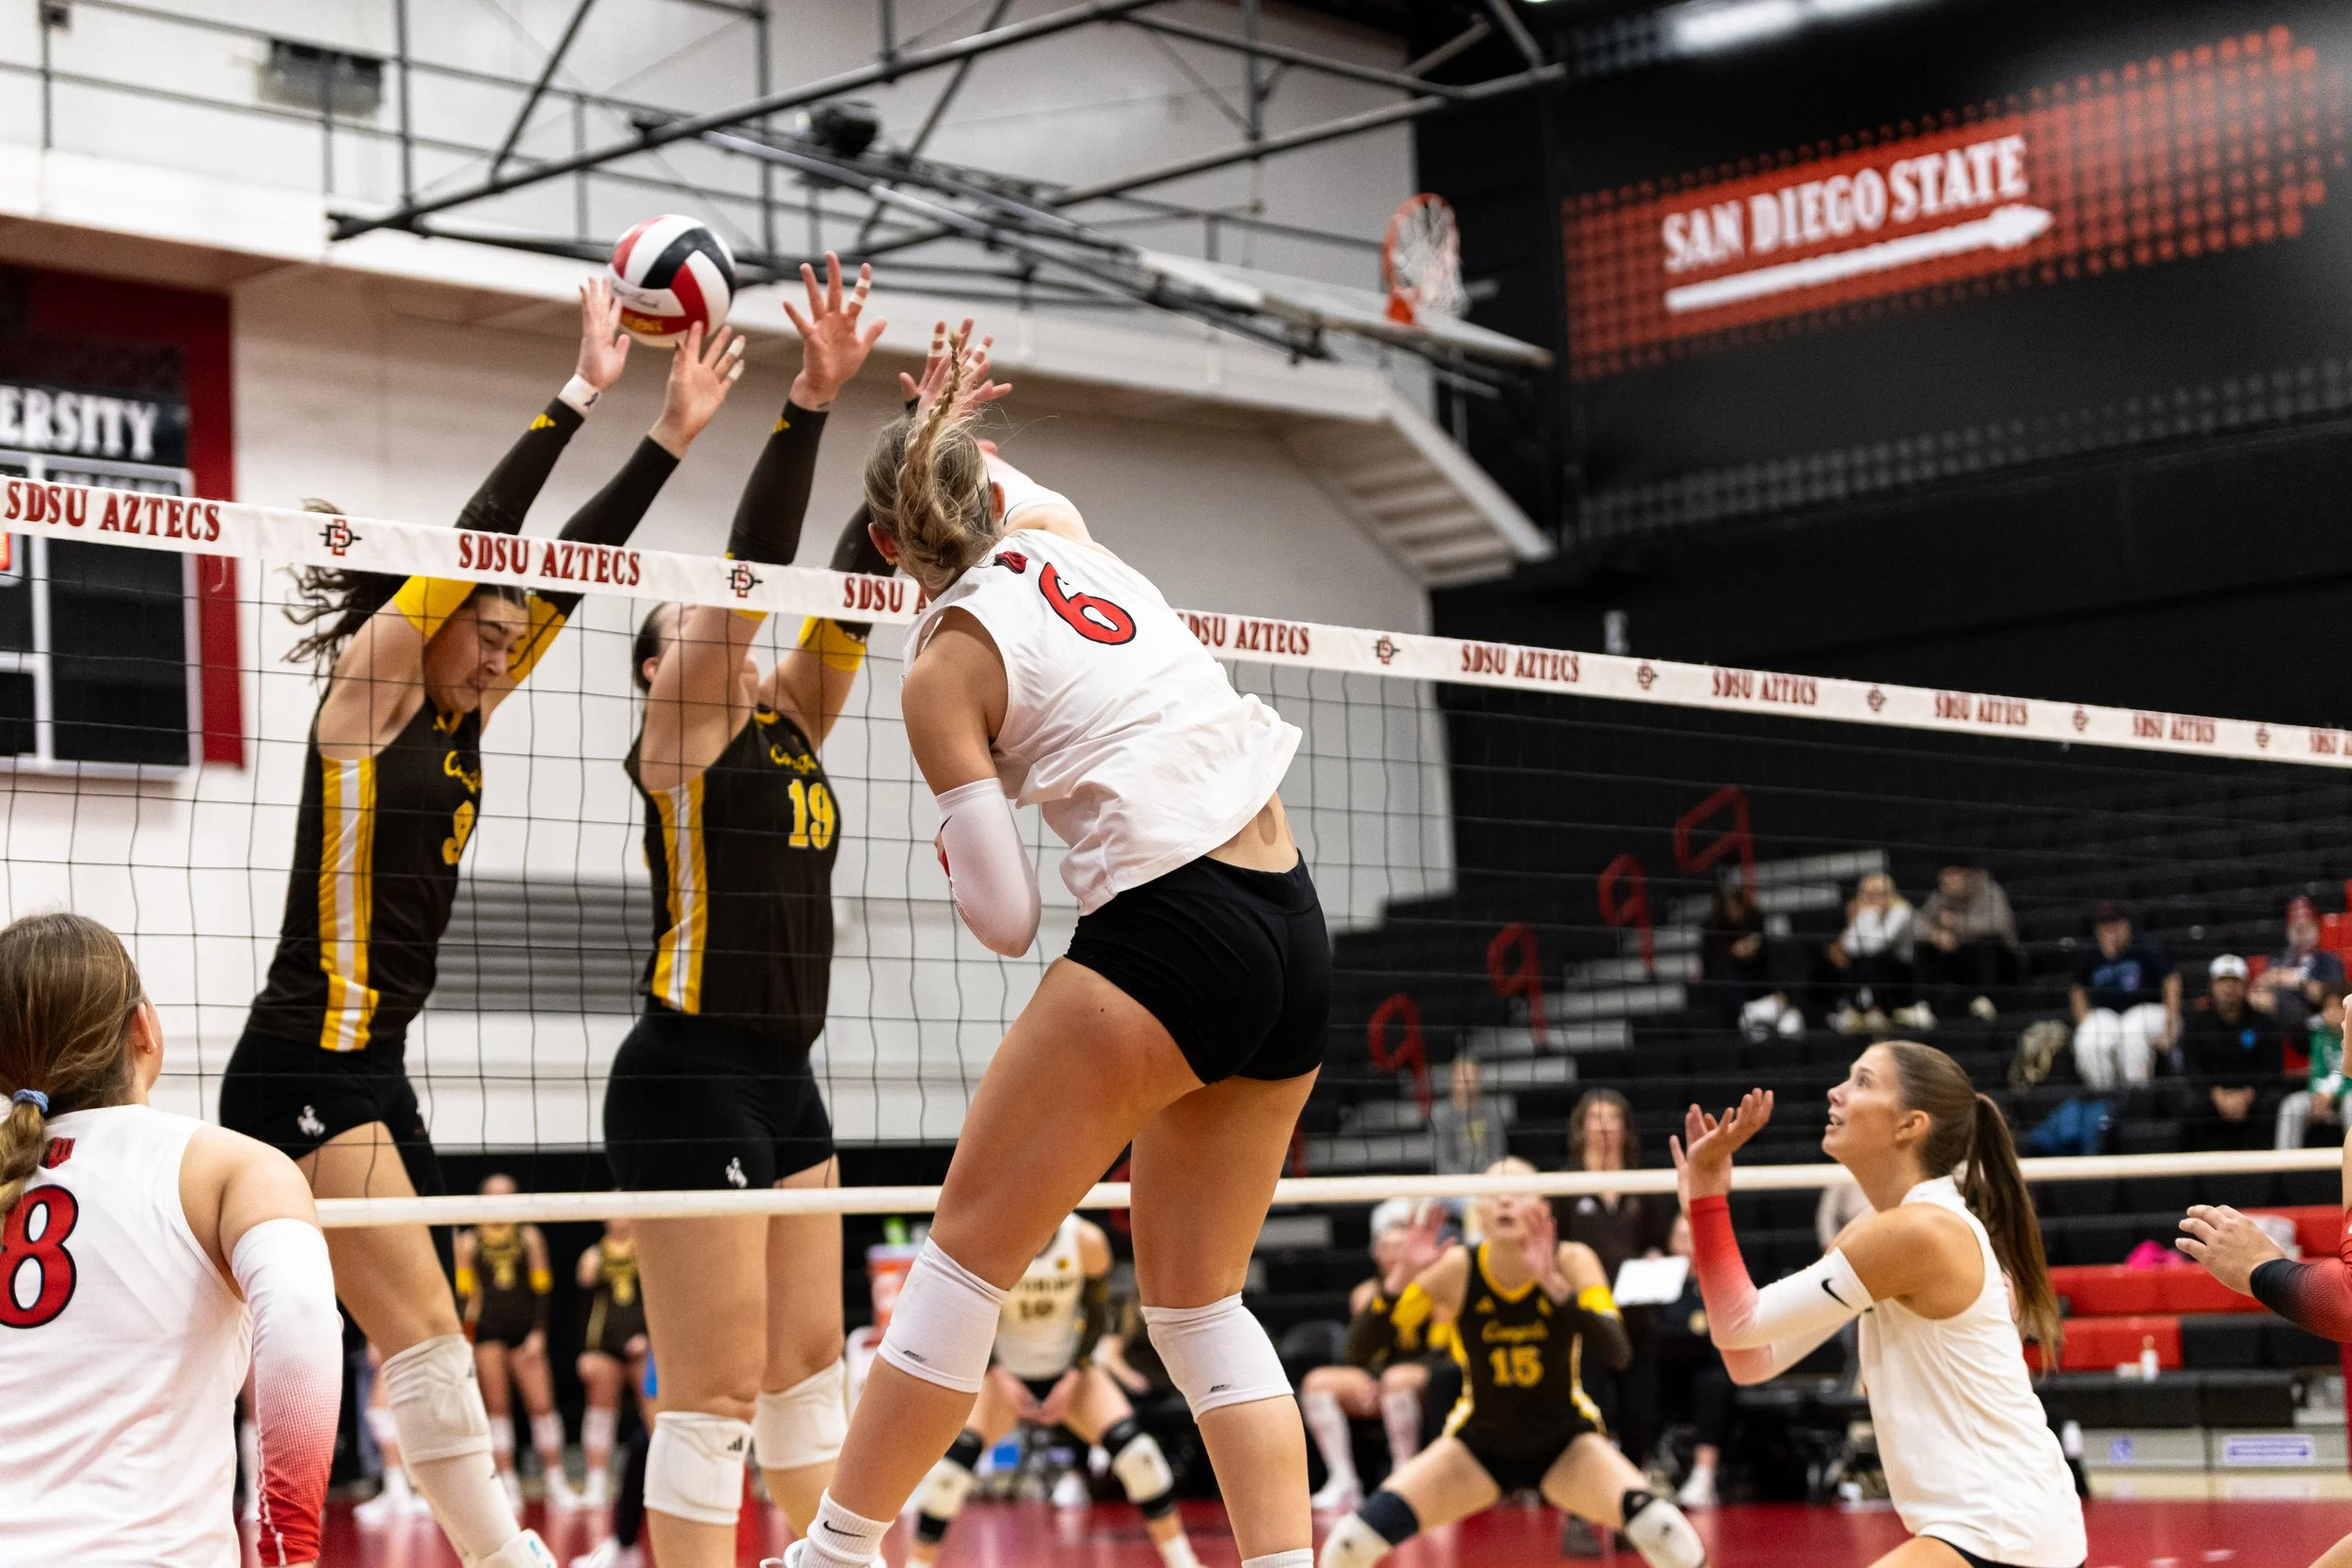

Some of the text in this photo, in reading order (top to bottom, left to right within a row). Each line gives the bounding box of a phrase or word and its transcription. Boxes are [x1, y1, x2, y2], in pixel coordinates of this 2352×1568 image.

[1661, 135, 2029, 274] SAN DIEGO STATE
[5, 480, 88, 528] SDSU
[98, 492, 221, 543] AZTECS
[458, 532, 641, 587] SDSU AZTECS
[842, 576, 904, 613] SDSU
[1038, 562, 1137, 646] 6
[1233, 620, 1311, 656] AZTECS
[1461, 643, 1580, 683] SDSU AZTECS
[1711, 666, 1754, 700] SDSU
[787, 778, 834, 851] 19
[0, 1183, 79, 1329] 8
[1488, 1345, 1545, 1388] 15
